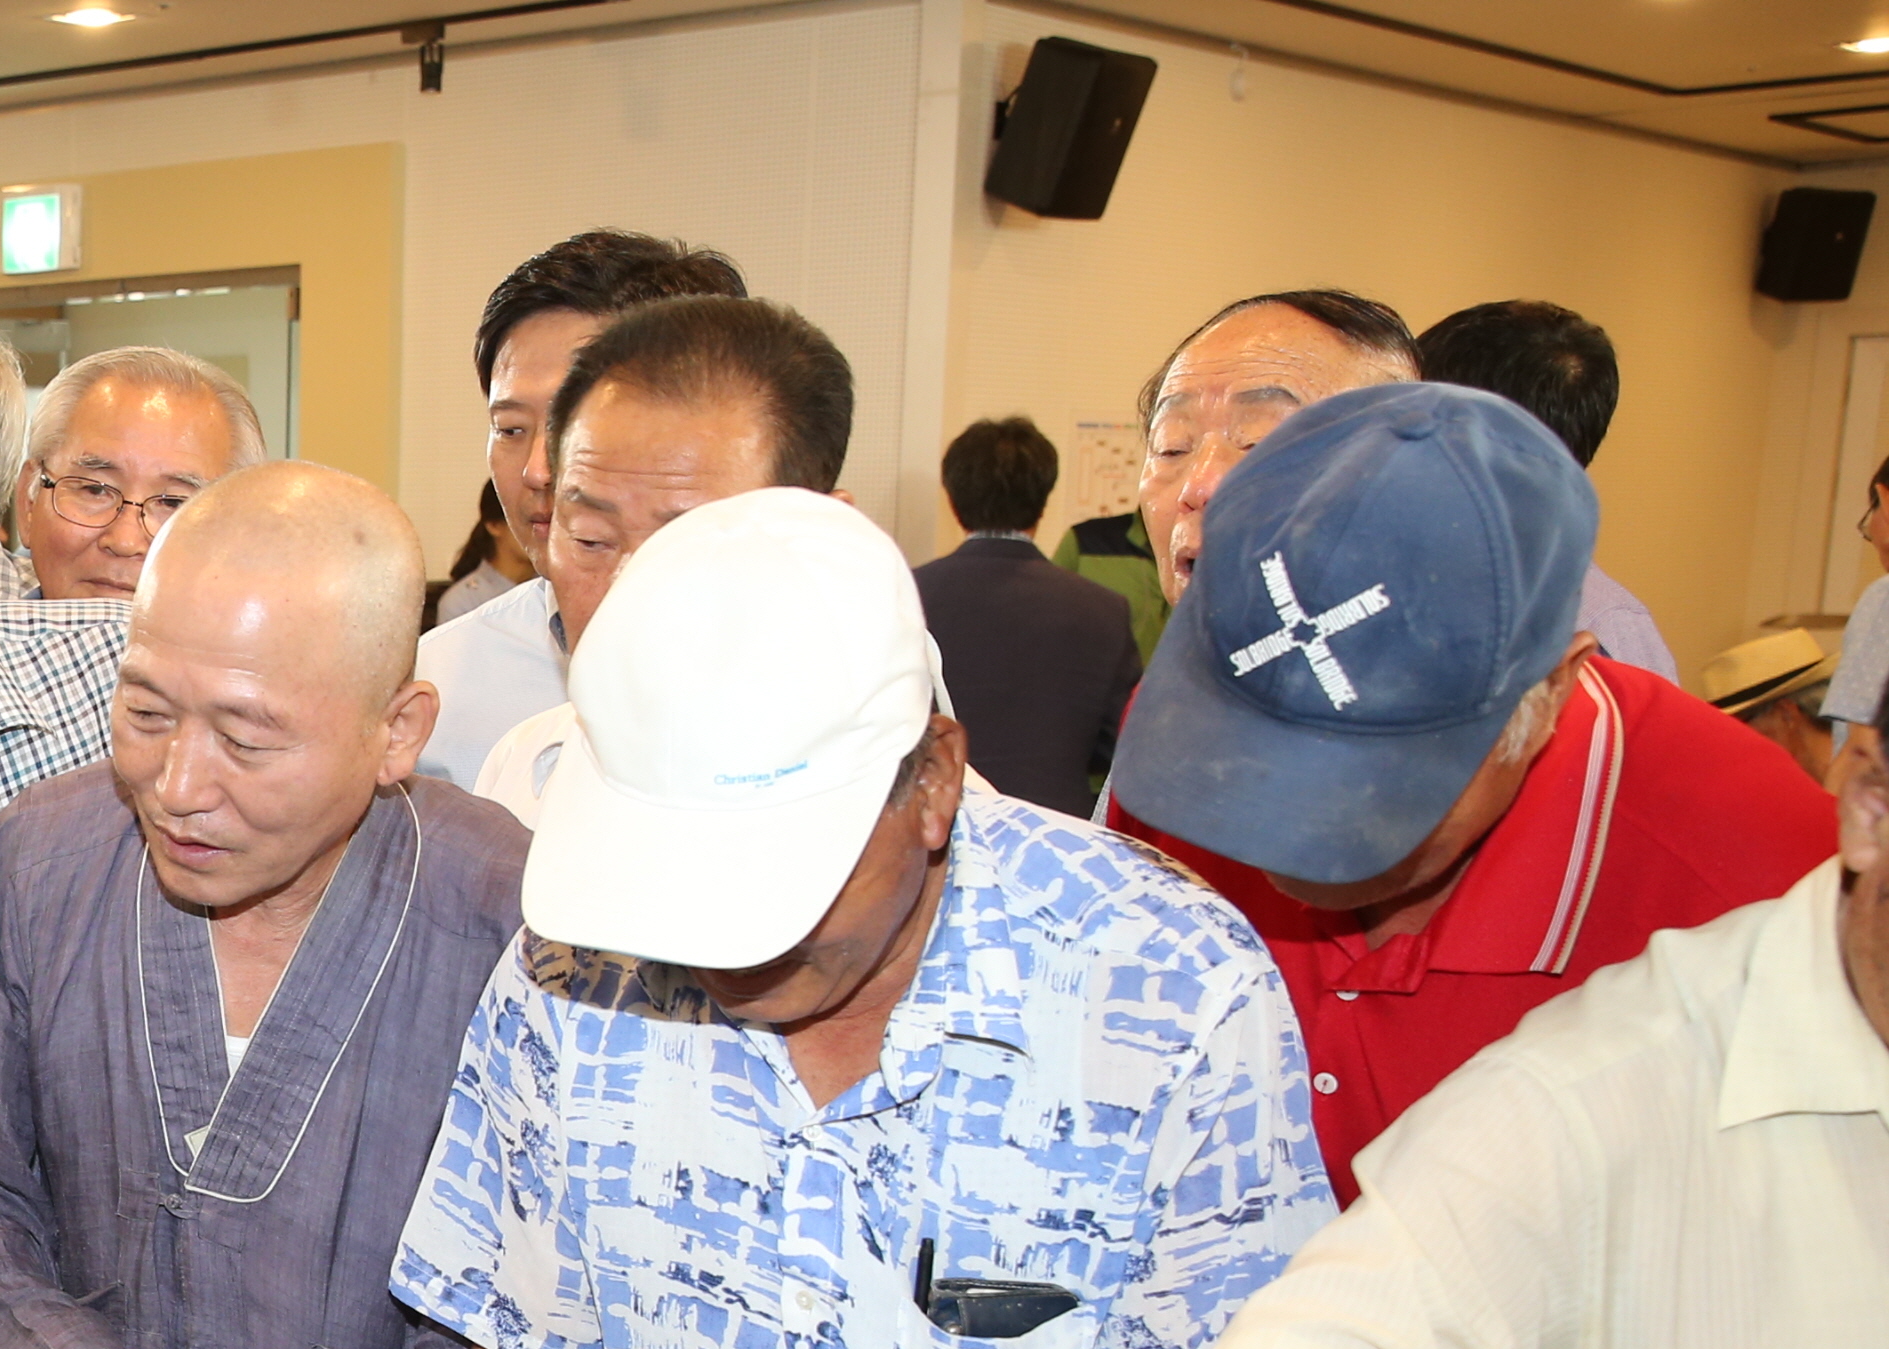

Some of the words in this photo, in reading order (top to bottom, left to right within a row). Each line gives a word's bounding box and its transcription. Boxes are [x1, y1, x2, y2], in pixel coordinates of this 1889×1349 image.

[1259, 550, 1307, 629] SOLBRIDGE
[1307, 583, 1391, 638] SOLBRIDGE
[1229, 628, 1302, 677] SOLBRIDGE
[1302, 638, 1358, 711] SOLBRIDGE
[713, 773, 770, 785] Christian
